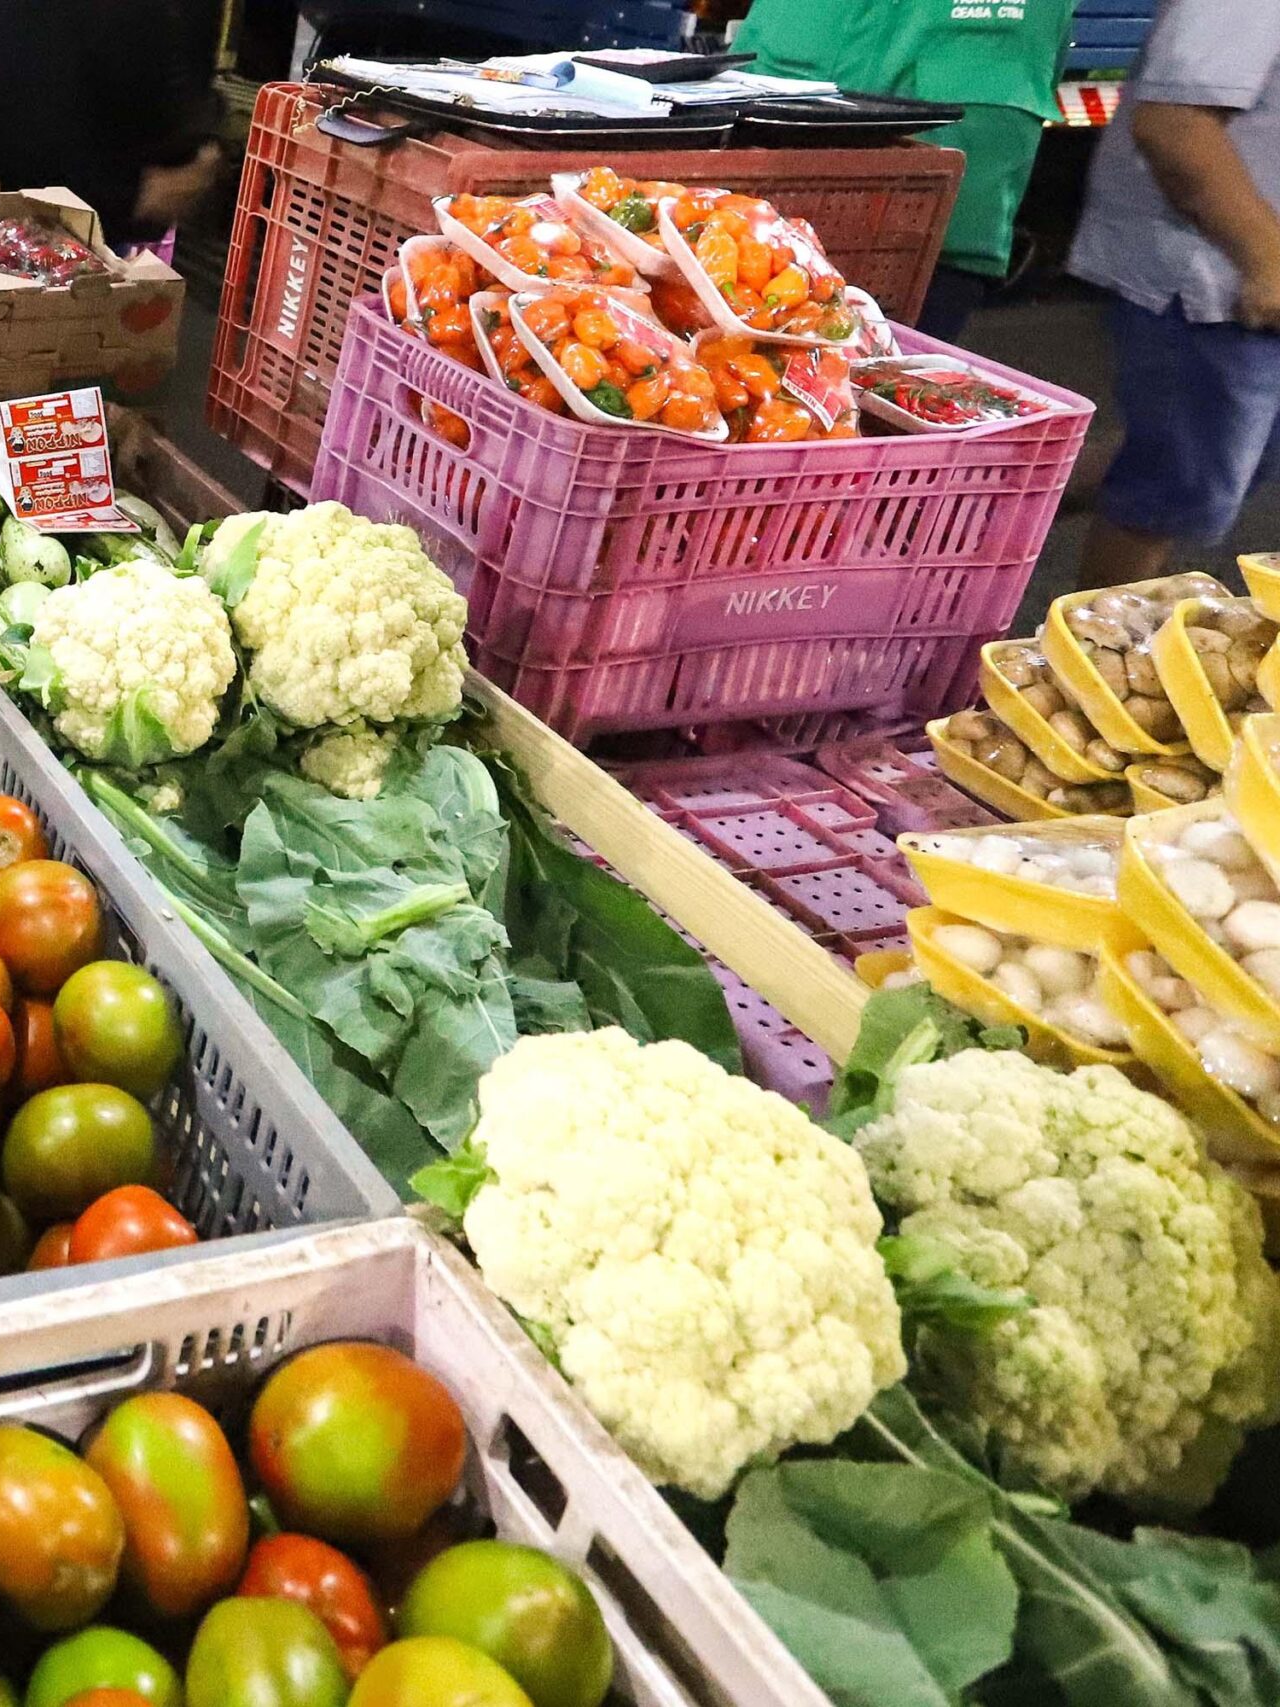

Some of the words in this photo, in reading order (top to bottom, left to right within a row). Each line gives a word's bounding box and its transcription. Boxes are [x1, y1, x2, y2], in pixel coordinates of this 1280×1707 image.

[277, 235, 309, 340] NIKKEY
[26, 432, 83, 453] NIPPON
[34, 491, 90, 513] NIPPON
[724, 584, 838, 617] NIKKEY
